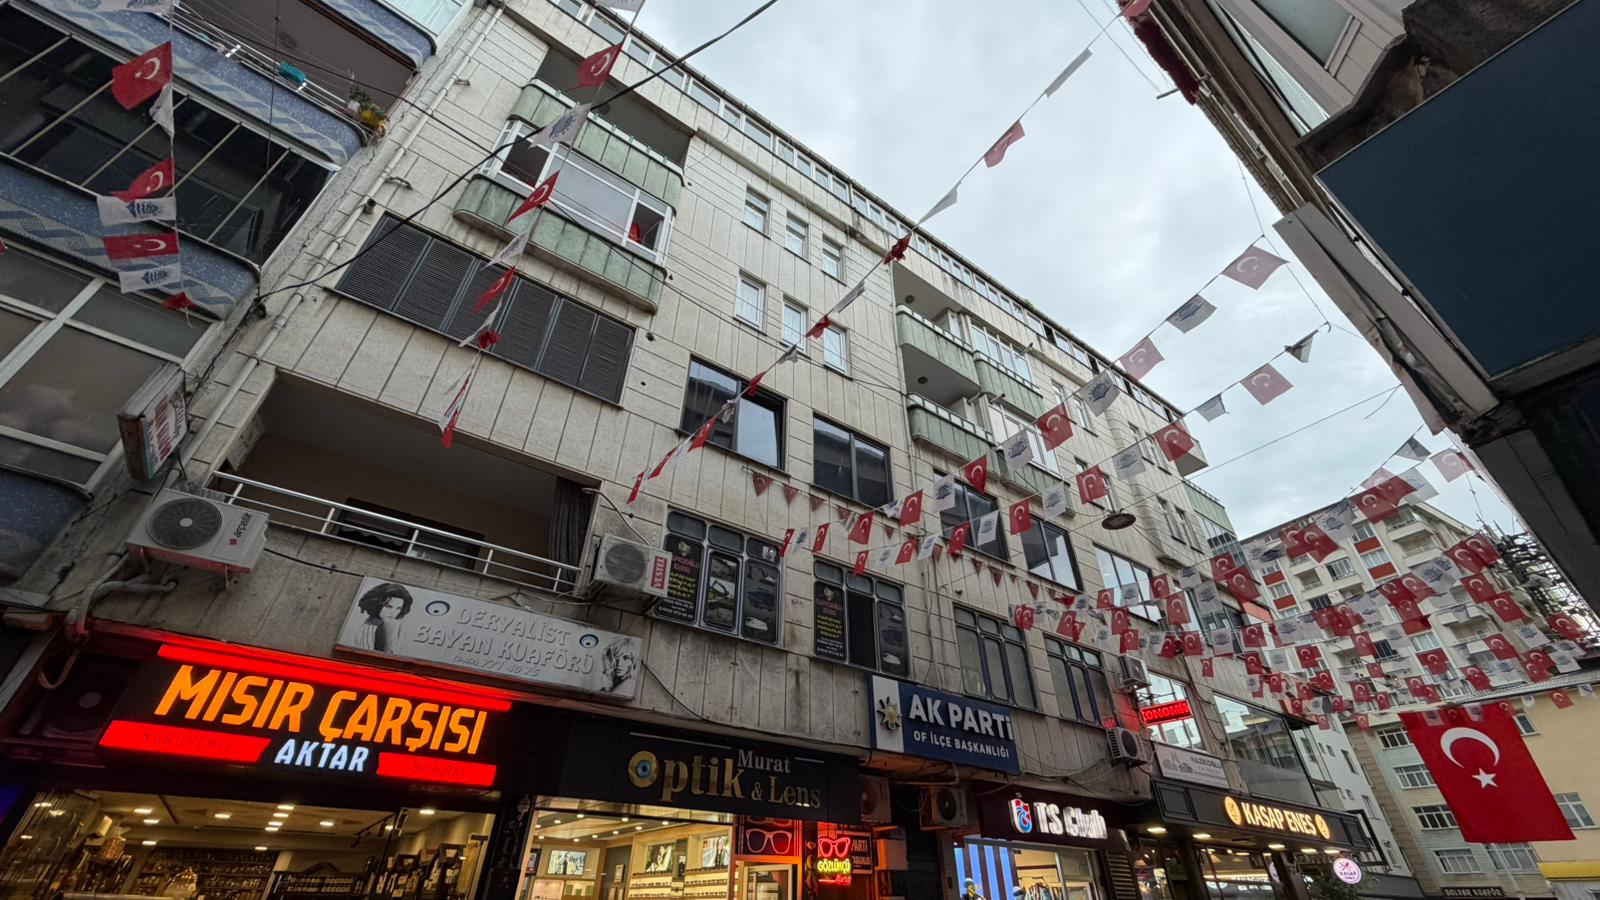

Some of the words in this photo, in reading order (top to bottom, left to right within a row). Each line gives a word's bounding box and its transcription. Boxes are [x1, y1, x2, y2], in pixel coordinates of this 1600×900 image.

[653, 557, 667, 588] VESTEL
[456, 607, 571, 646] DERYALİST
[413, 625, 492, 656] BAYAN
[498, 639, 596, 675] KUAFÖRÜ
[154, 664, 315, 732] MISIR
[318, 690, 488, 755] ÇARŞISI
[909, 694, 945, 726] AK
[274, 738, 370, 772] AKTAR
[737, 749, 791, 774] Murat
[914, 730, 927, 742] OF
[930, 730, 952, 749] İLÇE
[954, 738, 1010, 759] BAŞKANLIĞI
[628, 750, 745, 802] Optik
[751, 782, 764, 801] &
[768, 775, 822, 808] Lens
[1241, 801, 1285, 829] KASAP
[1283, 810, 1318, 836] ENES
